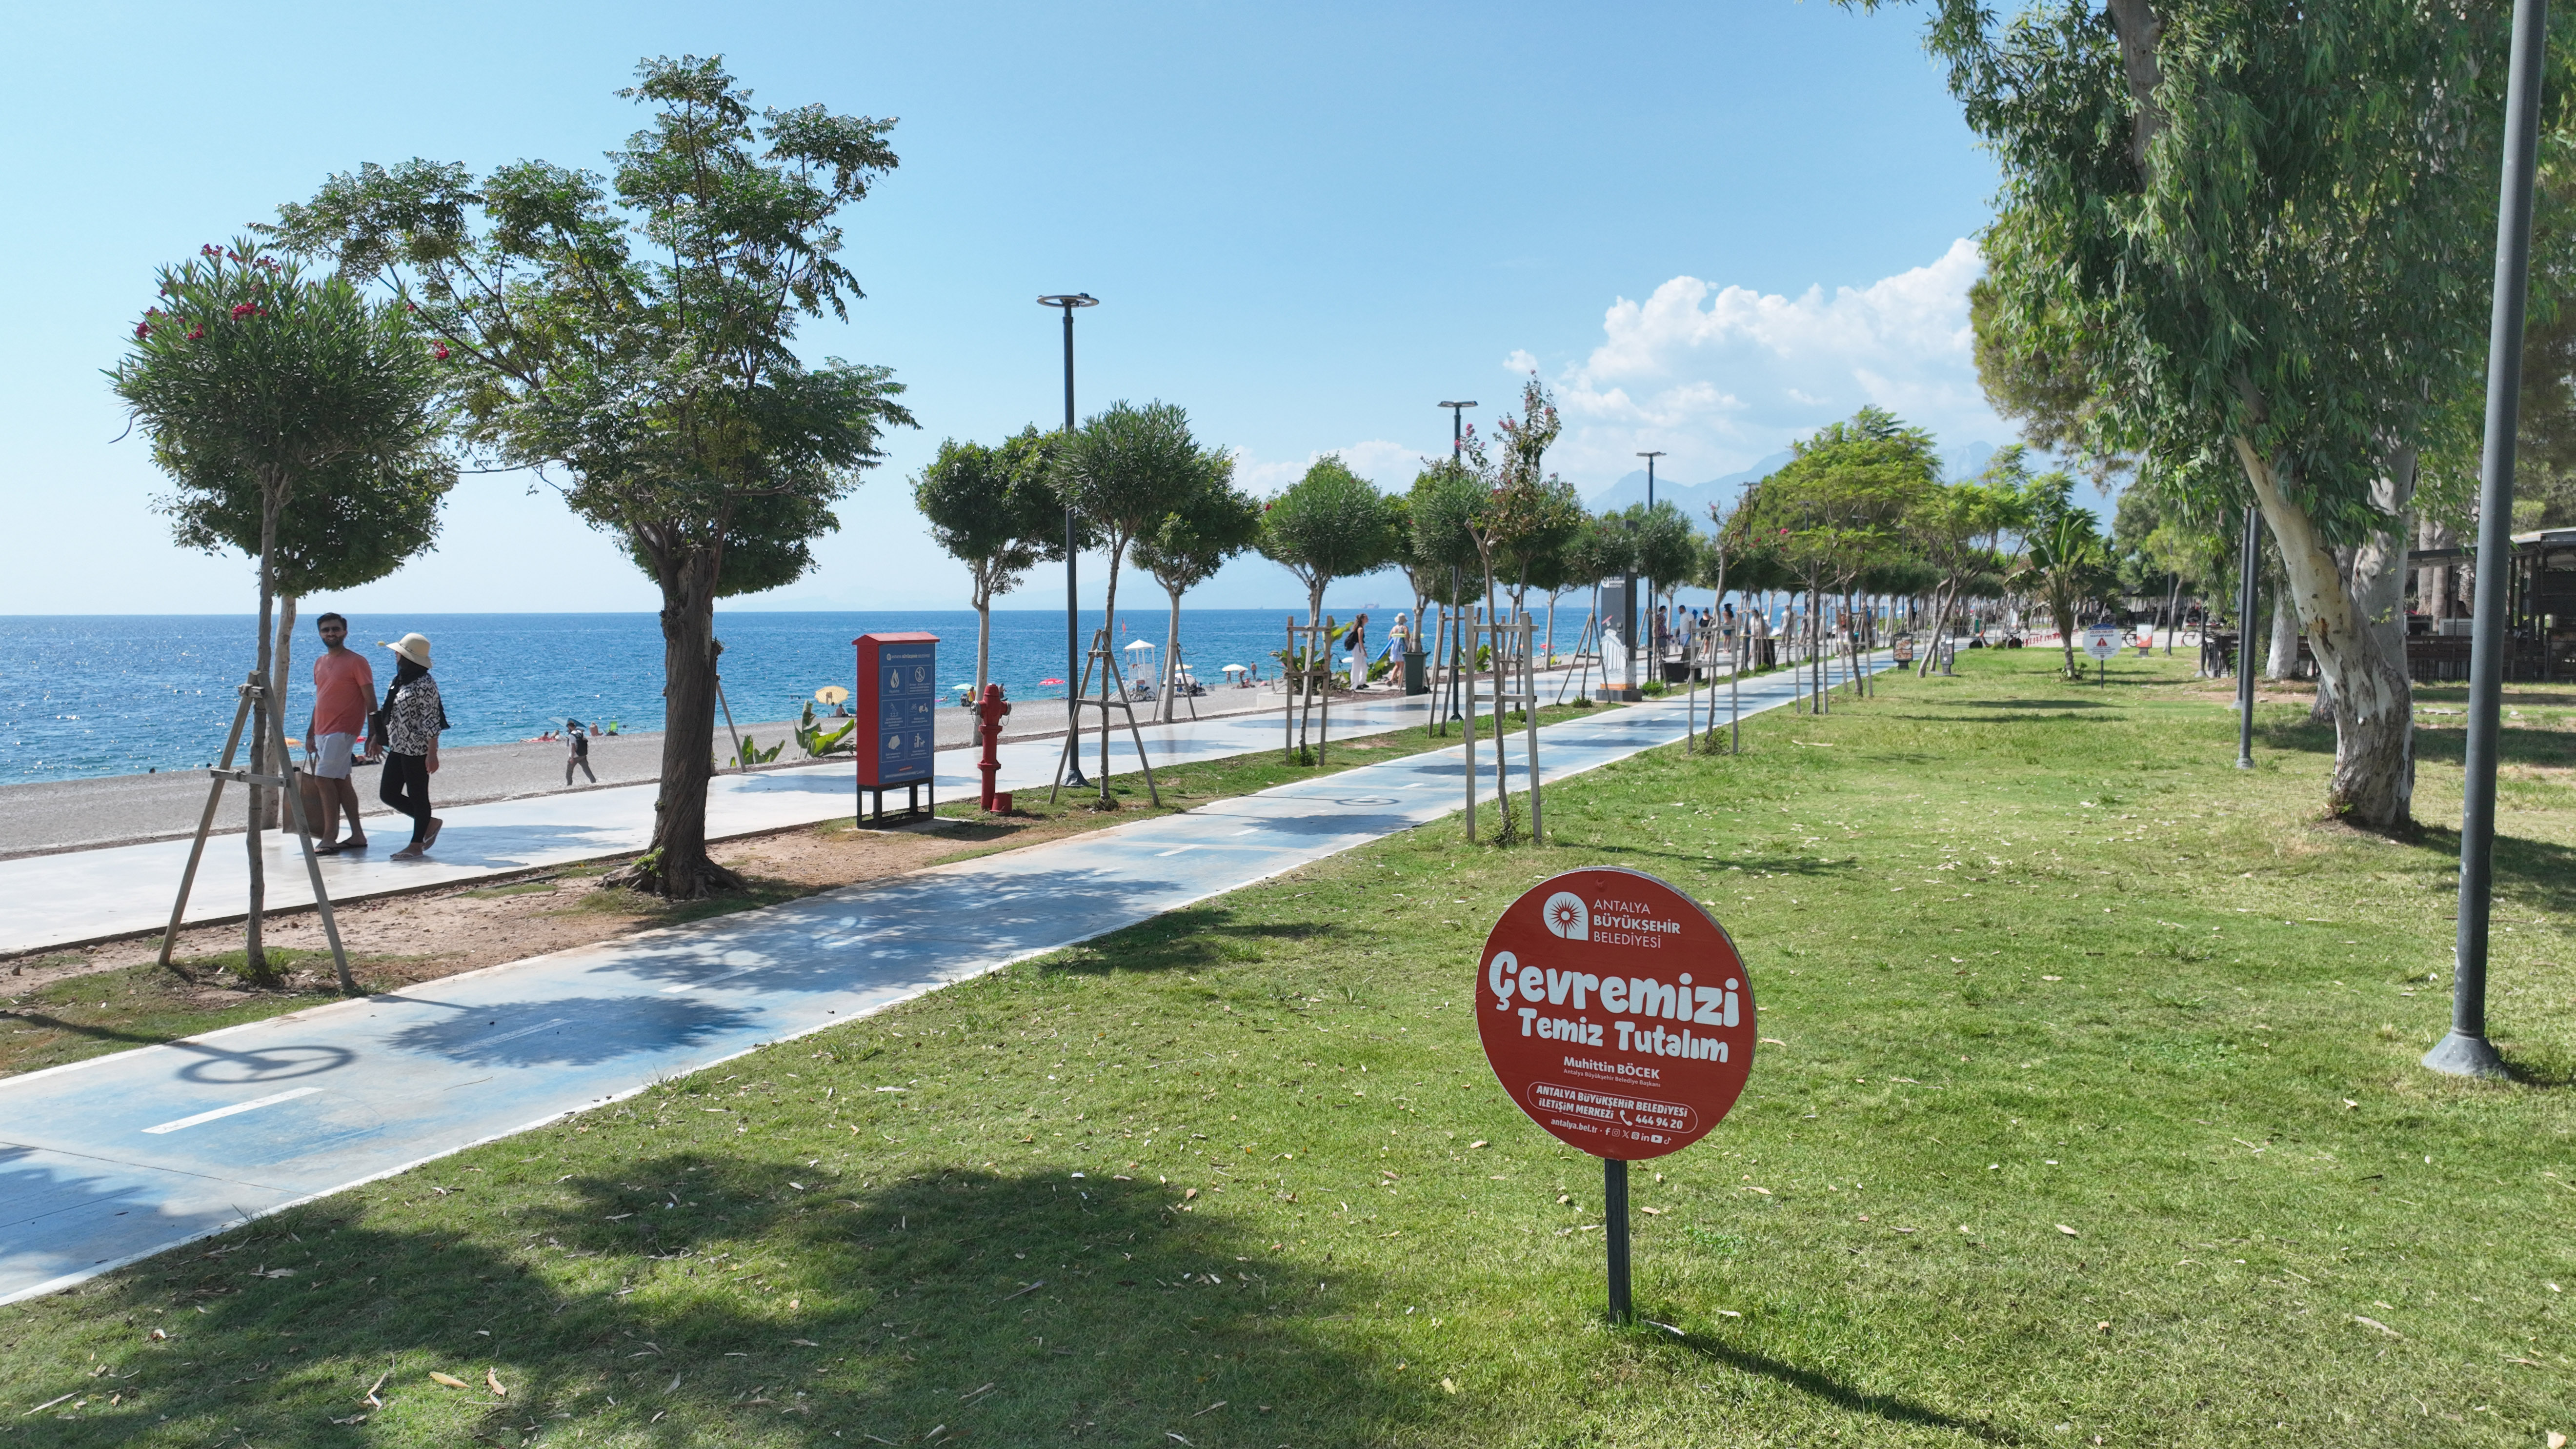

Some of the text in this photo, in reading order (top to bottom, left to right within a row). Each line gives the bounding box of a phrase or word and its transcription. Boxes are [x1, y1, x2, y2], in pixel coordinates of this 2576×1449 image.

[1593, 899, 1650, 914] ANTALYA
[1593, 913, 1681, 934] BÜYÜKŞEHİR
[1594, 932, 1661, 948] BELEDİYESİ
[1489, 951, 1740, 1027] Çevremizi
[1518, 1007, 1729, 1063] Temiz Tutalım
[1564, 1056, 1660, 1080] Muhittin BÖCEK
[1564, 1068, 1661, 1087] Antalya Büyükşehir Belediye Başkanı
[1536, 1085, 1688, 1117] ANTALYA BÜYÜKŞEHİR BELEDİYESİ
[1539, 1098, 1683, 1129] İLETİŞİM MERKEZİ 444 94 20
[1550, 1118, 1598, 1133] antalya.bel.tr
